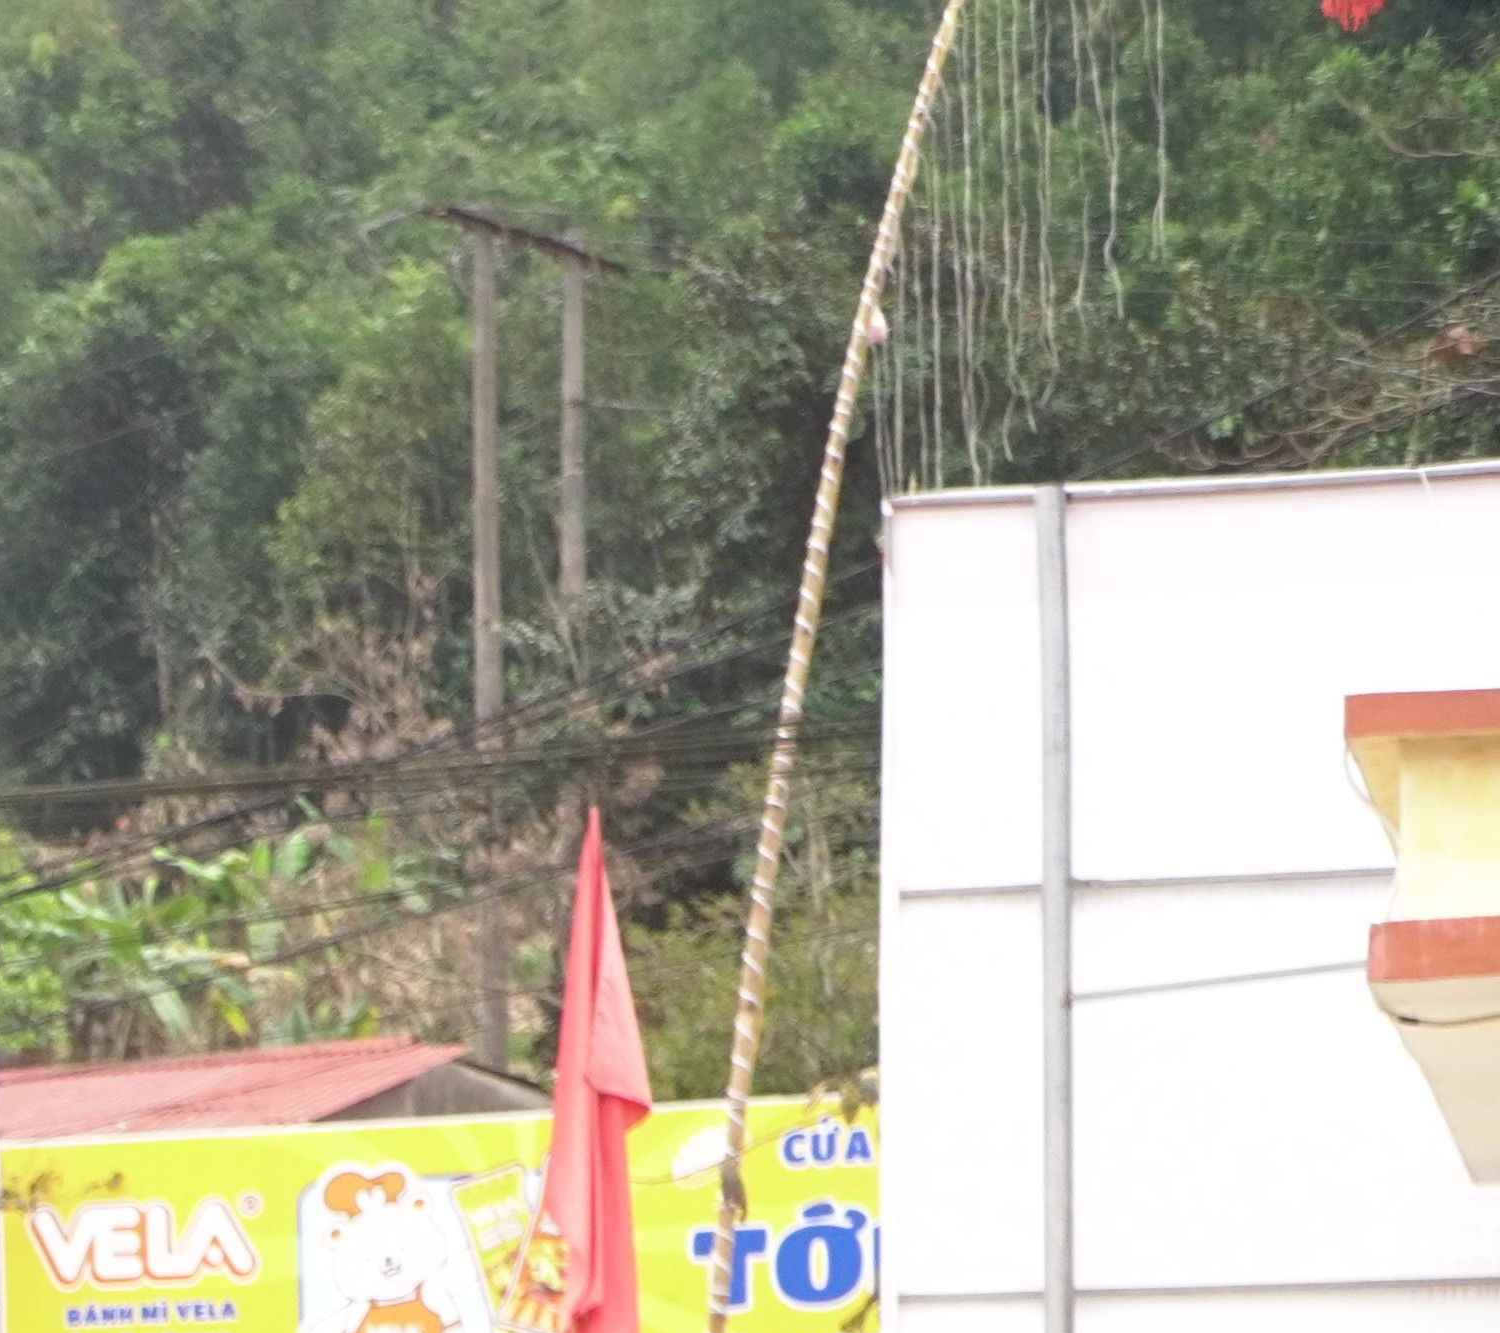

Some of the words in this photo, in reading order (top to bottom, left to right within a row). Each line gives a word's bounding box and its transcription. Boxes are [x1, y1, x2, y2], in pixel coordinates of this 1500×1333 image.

[29, 1199, 257, 1286] VELA
[65, 1303, 134, 1325] BÁNH
[175, 1301, 237, 1322] VELA
